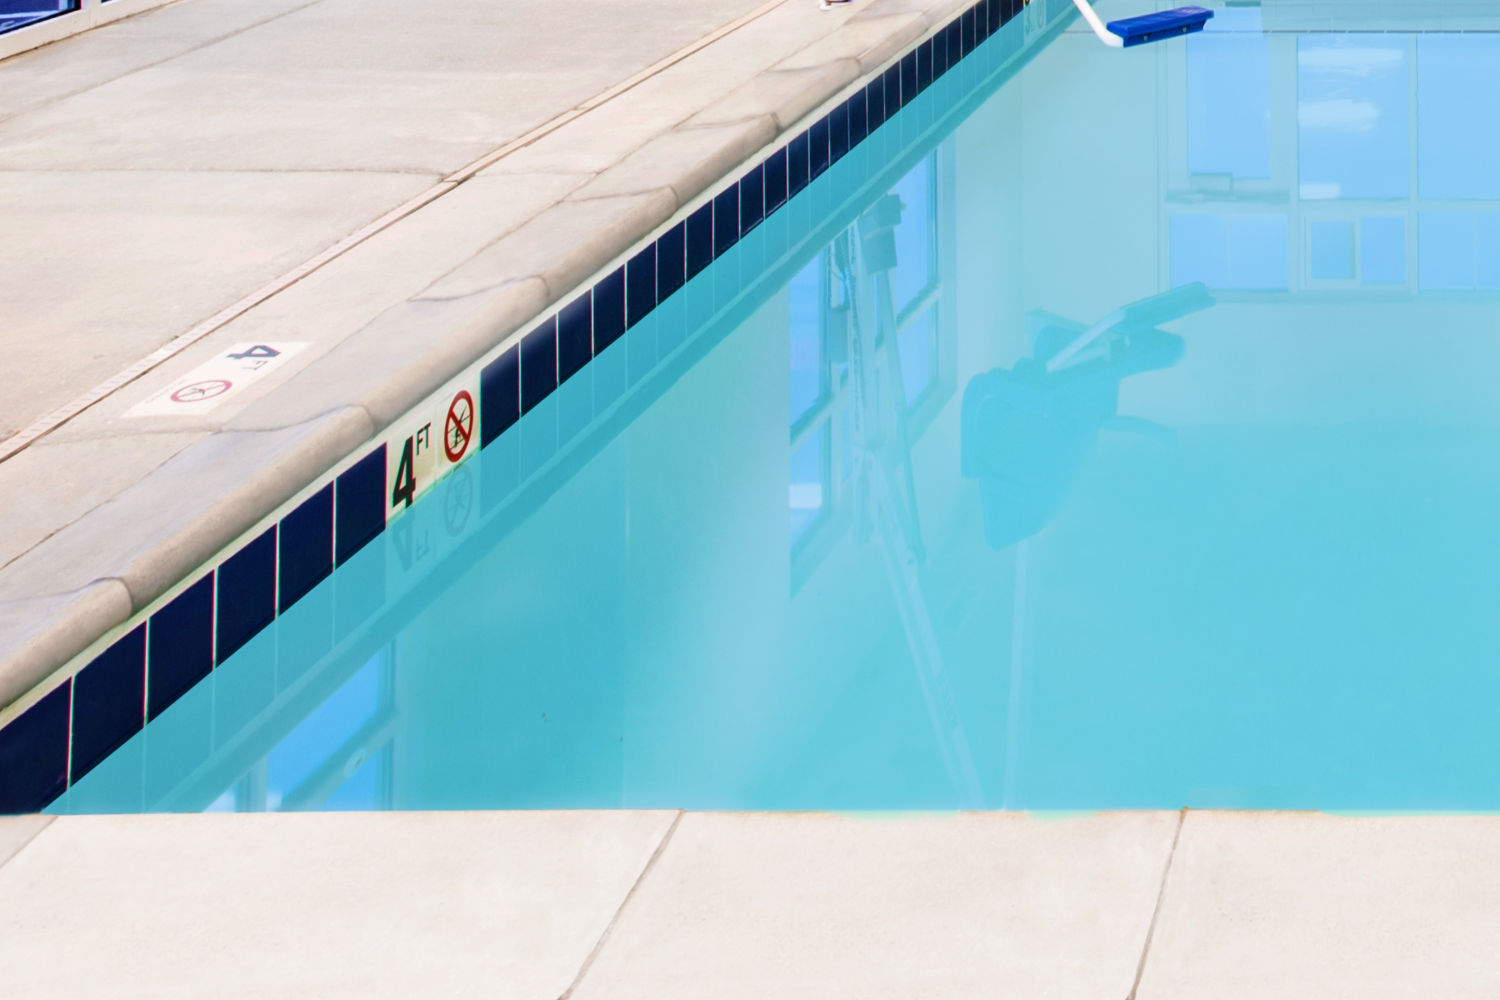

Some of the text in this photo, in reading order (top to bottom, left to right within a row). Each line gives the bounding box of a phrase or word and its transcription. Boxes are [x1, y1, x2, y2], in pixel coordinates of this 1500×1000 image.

[226, 344, 282, 360] 4
[392, 422, 432, 509] 4 FT
